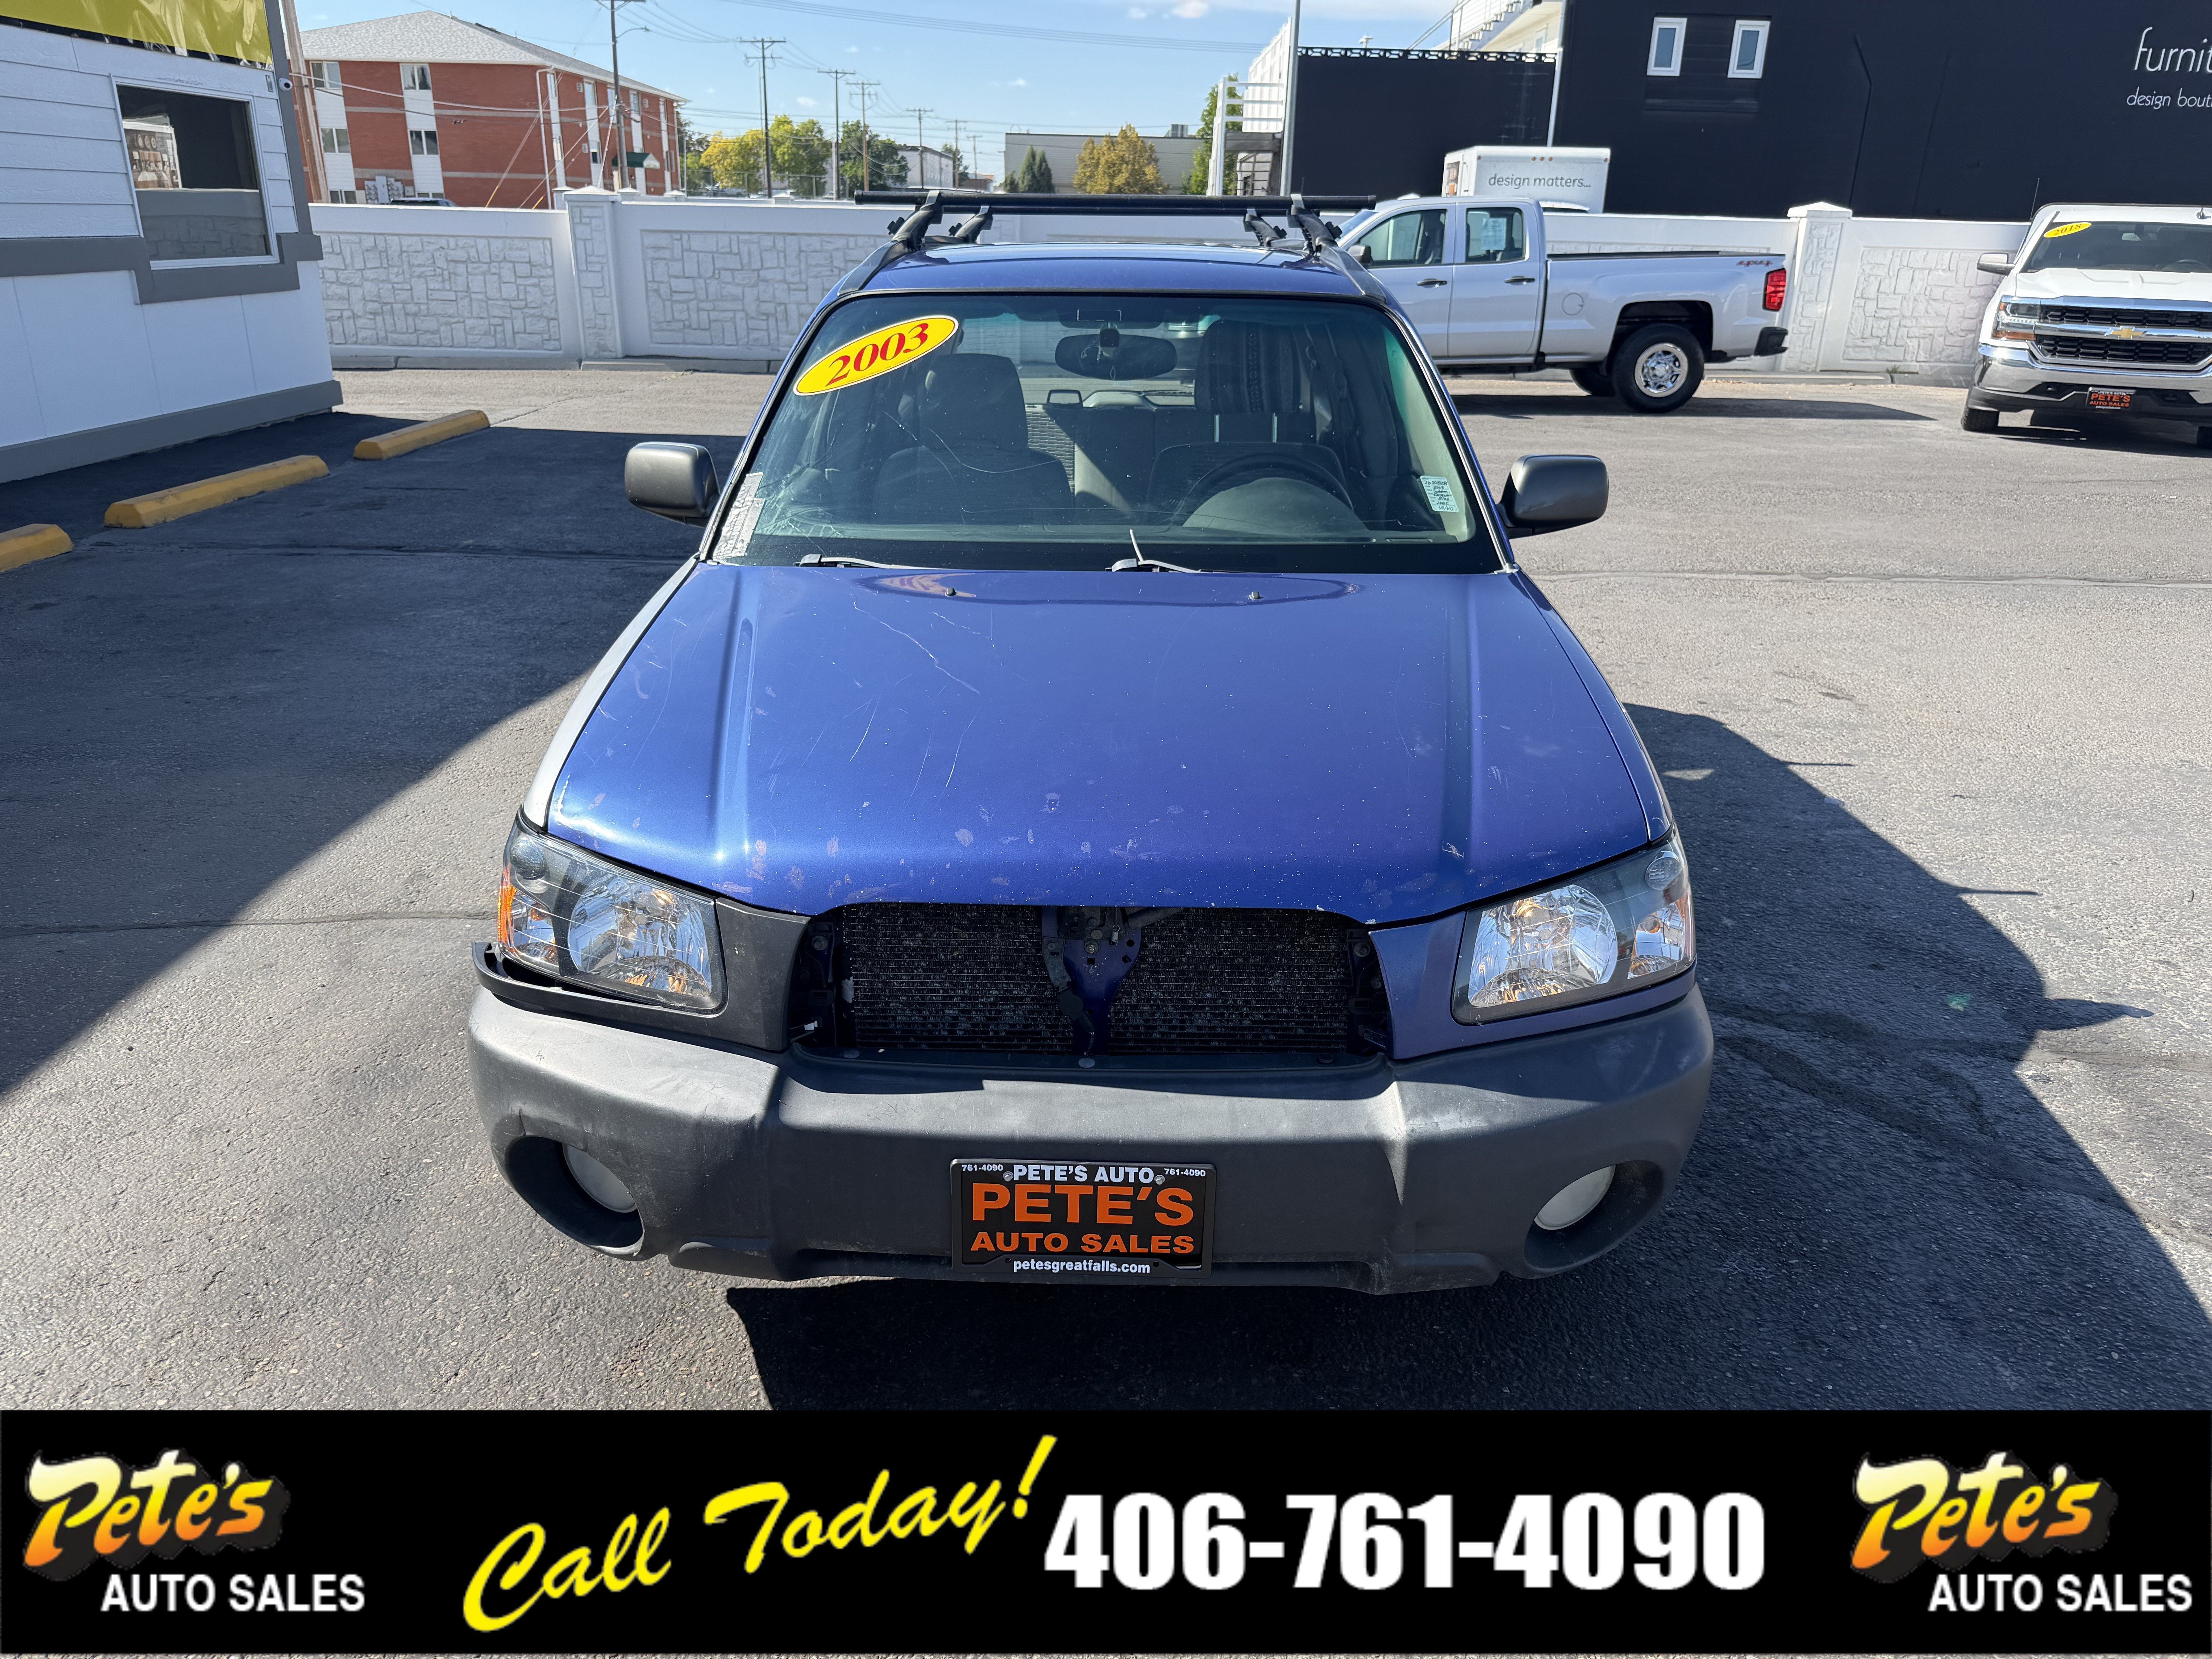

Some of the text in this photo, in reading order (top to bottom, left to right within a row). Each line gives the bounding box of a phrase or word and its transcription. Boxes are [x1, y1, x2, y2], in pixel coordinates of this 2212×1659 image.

[2126, 86, 2212, 110] design bout
[1488, 173, 1592, 190] design matters...
[2054, 223, 2082, 236] 2018
[825, 323, 929, 387] 2003
[2091, 393, 2131, 402] PETE'S
[1013, 1165, 1154, 1183] PETE'S AUTO
[1164, 1167, 1206, 1177] 761-4090
[972, 1183, 1194, 1226] PETE'S
[970, 1232, 1195, 1254] AUTO SALES
[1013, 1258, 1151, 1274] petesgreatfalls.com
